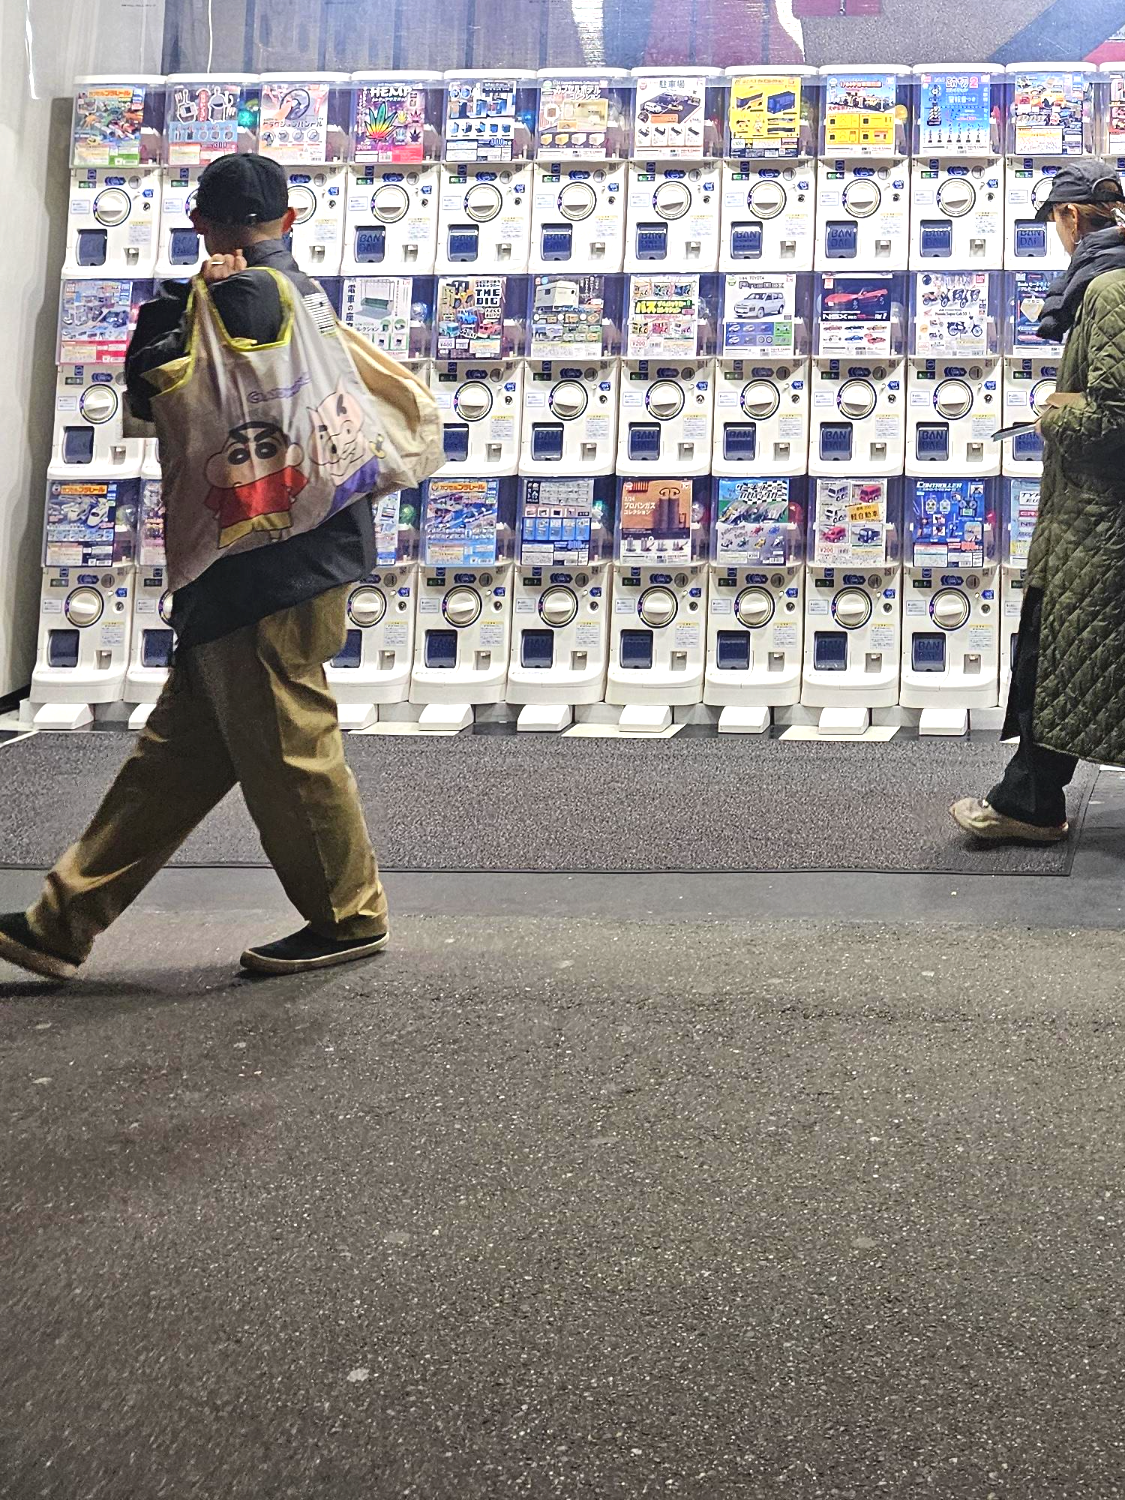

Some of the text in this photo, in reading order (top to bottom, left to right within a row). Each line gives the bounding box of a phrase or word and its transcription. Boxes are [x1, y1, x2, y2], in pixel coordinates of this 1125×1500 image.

[831, 229, 852, 238] BAN
[825, 430, 847, 440] BAN
[922, 430, 944, 440] BAN
